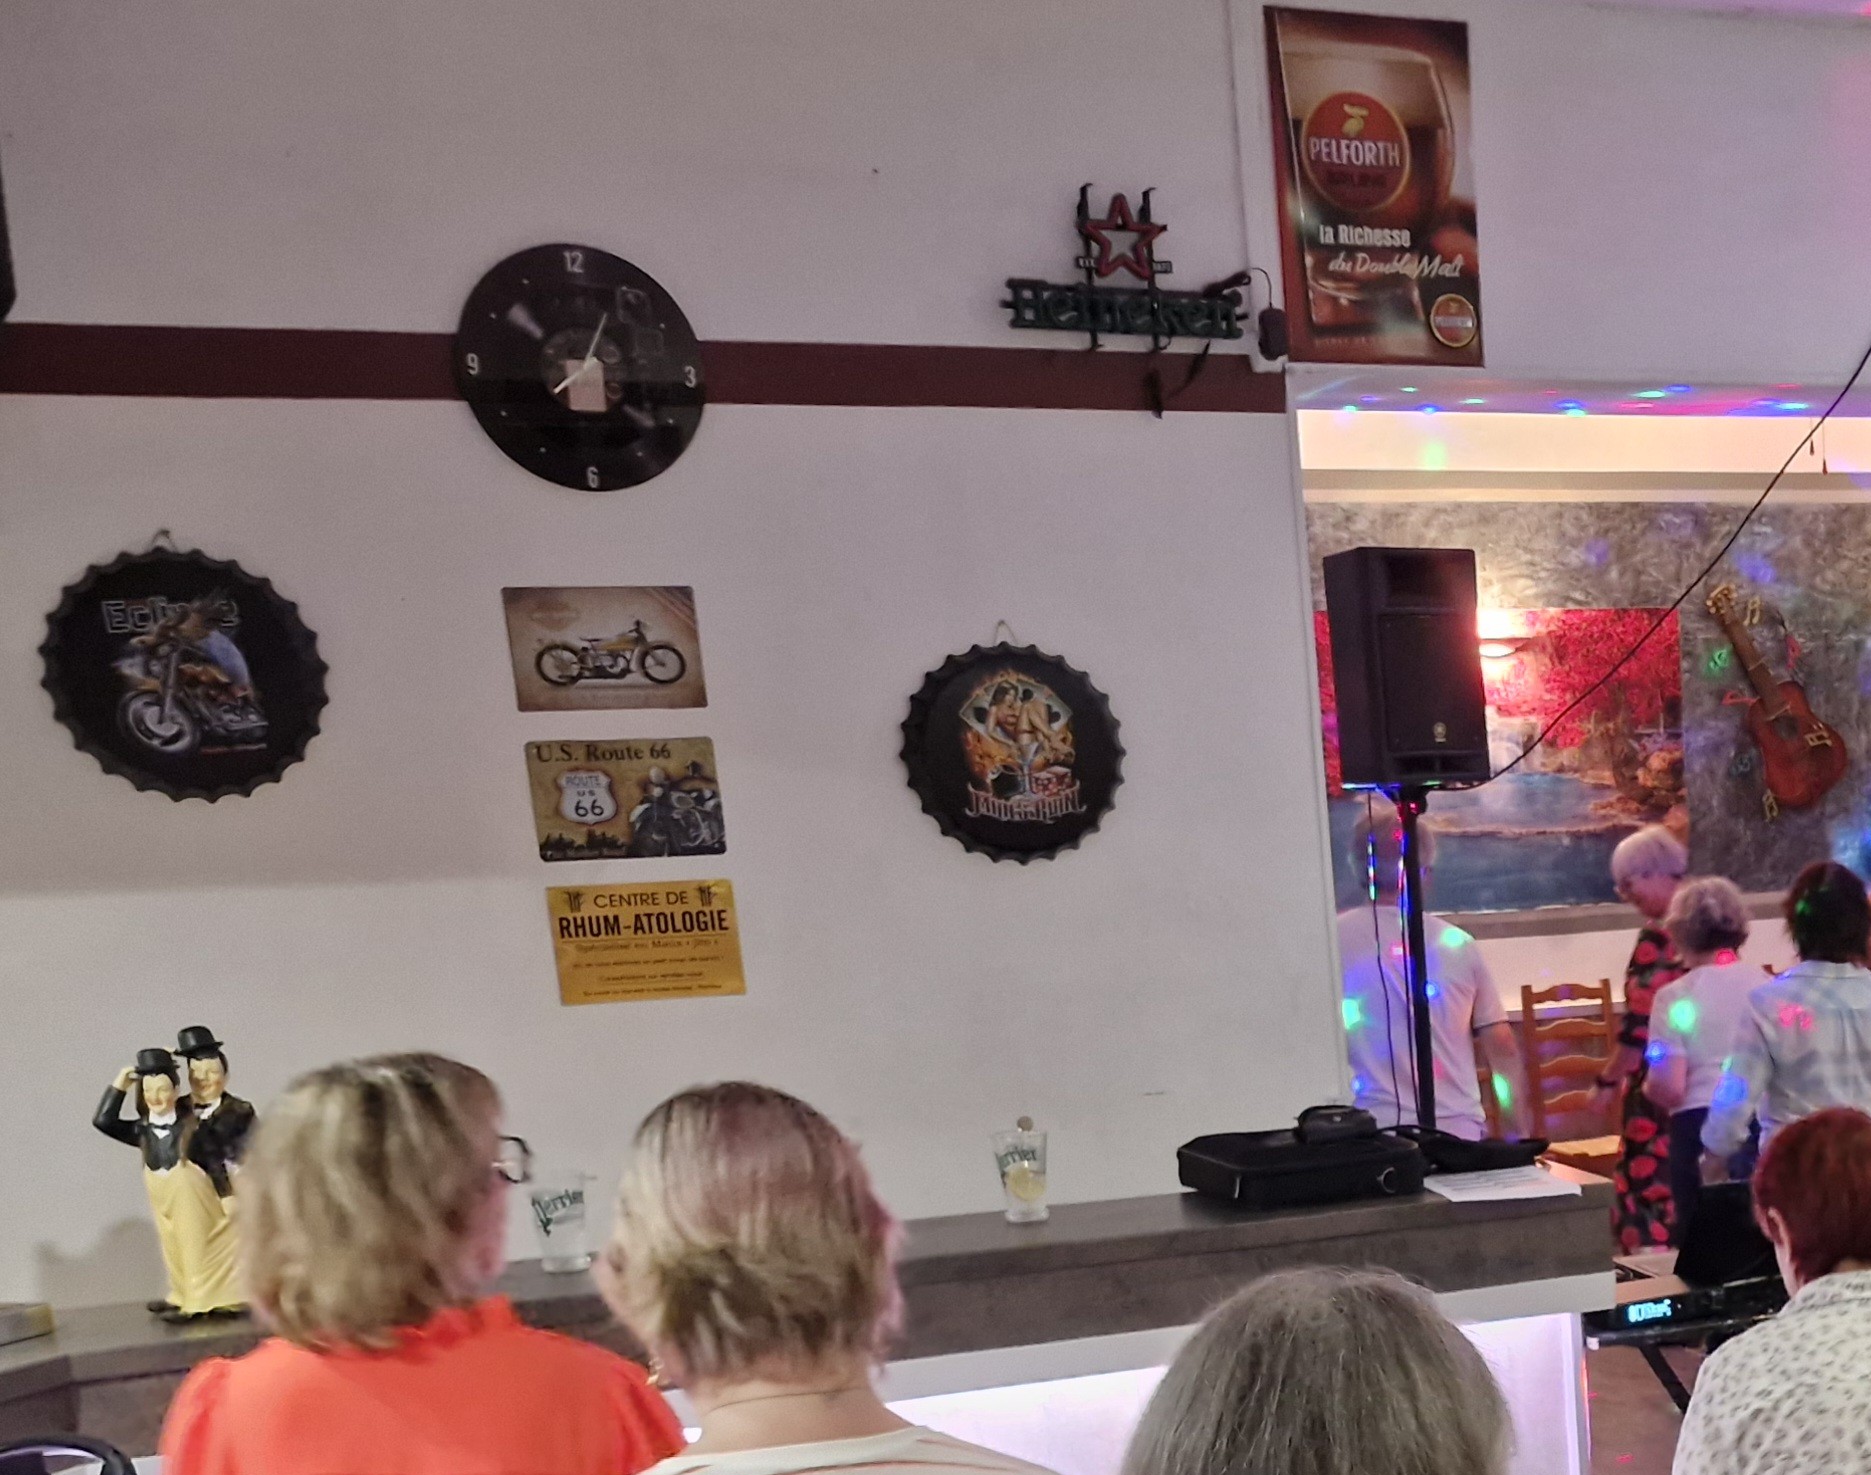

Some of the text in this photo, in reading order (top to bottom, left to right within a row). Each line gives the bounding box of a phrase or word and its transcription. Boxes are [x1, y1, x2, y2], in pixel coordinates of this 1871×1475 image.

[1309, 136, 1401, 168] PELFORTH
[1318, 224, 1336, 245] la
[563, 250, 585, 274] 12
[1006, 277, 1245, 340] Heineken
[466, 352, 480, 376] 9
[683, 365, 697, 389] 3
[586, 466, 599, 488] 6
[534, 743, 673, 764] U.S. Route 66
[575, 799, 605, 817] 66
[593, 891, 690, 909] CENTRE DE
[558, 909, 730, 939] RHUM-ATOLOGIE
